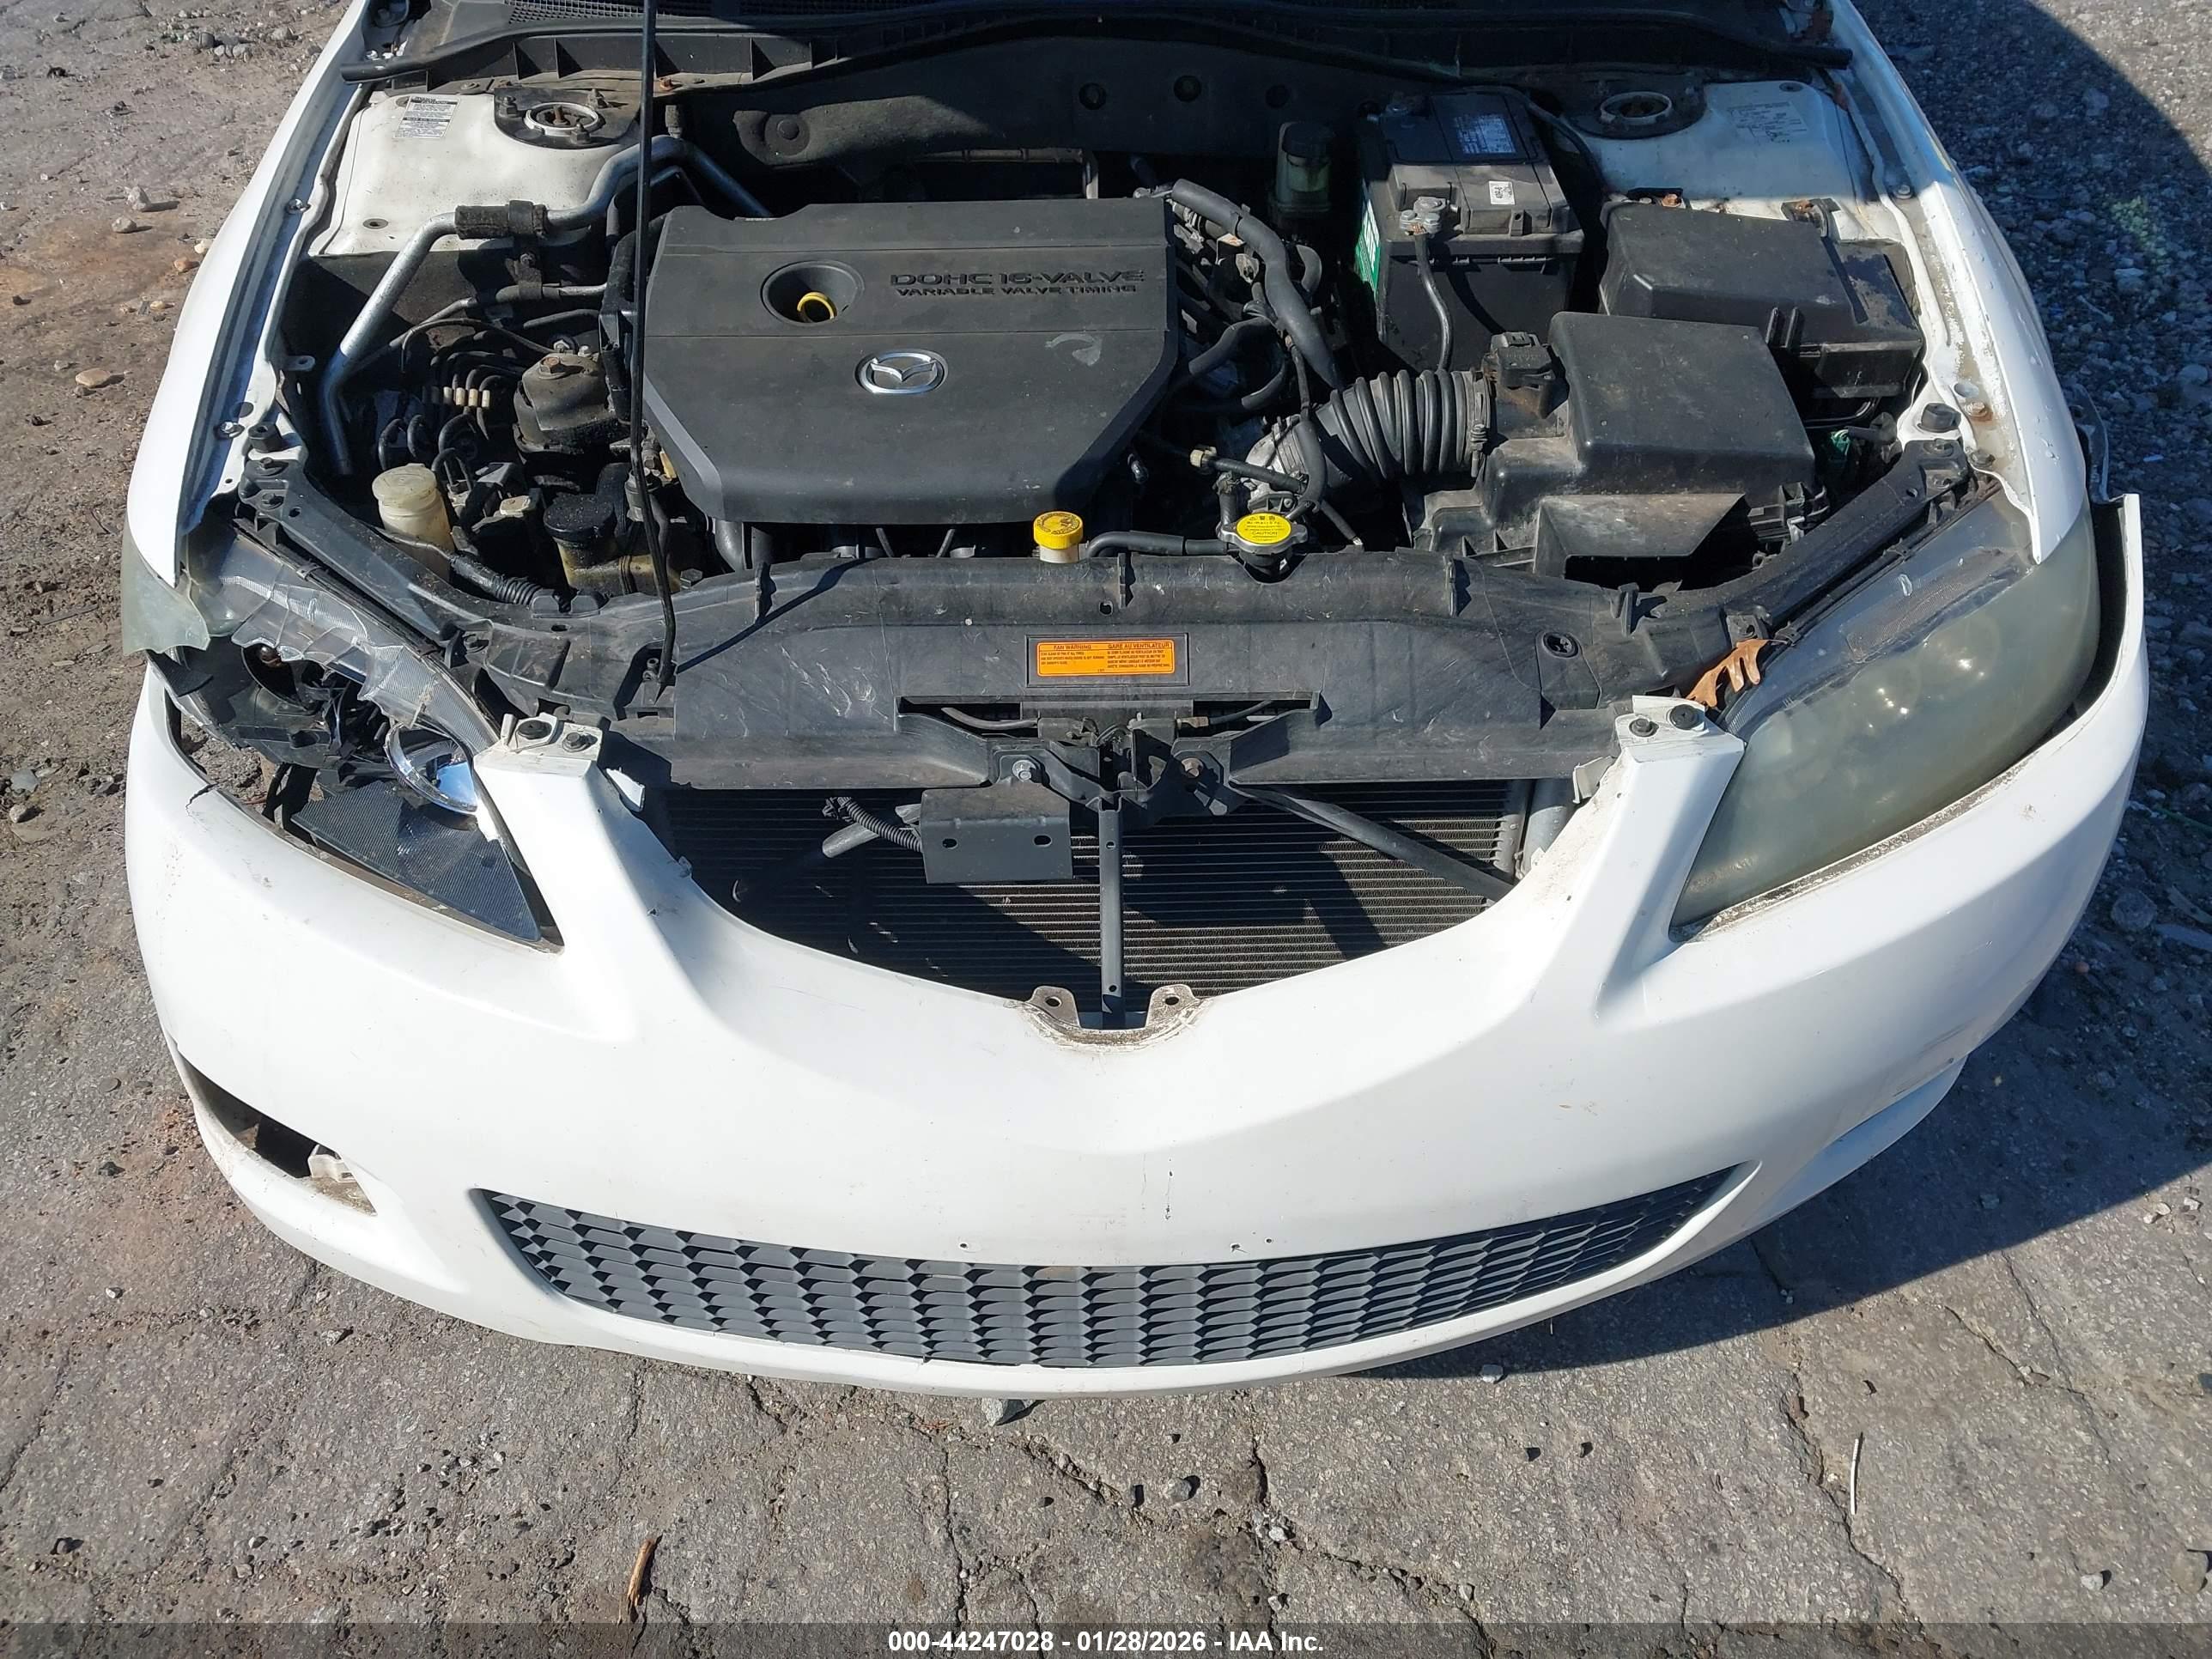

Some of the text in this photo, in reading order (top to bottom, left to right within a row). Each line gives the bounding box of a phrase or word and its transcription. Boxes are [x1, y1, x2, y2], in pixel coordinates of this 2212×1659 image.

[890, 270, 1145, 286] DOHC 16-VALVE
[896, 284, 1137, 296] VARIABLE VALVE TIMING
